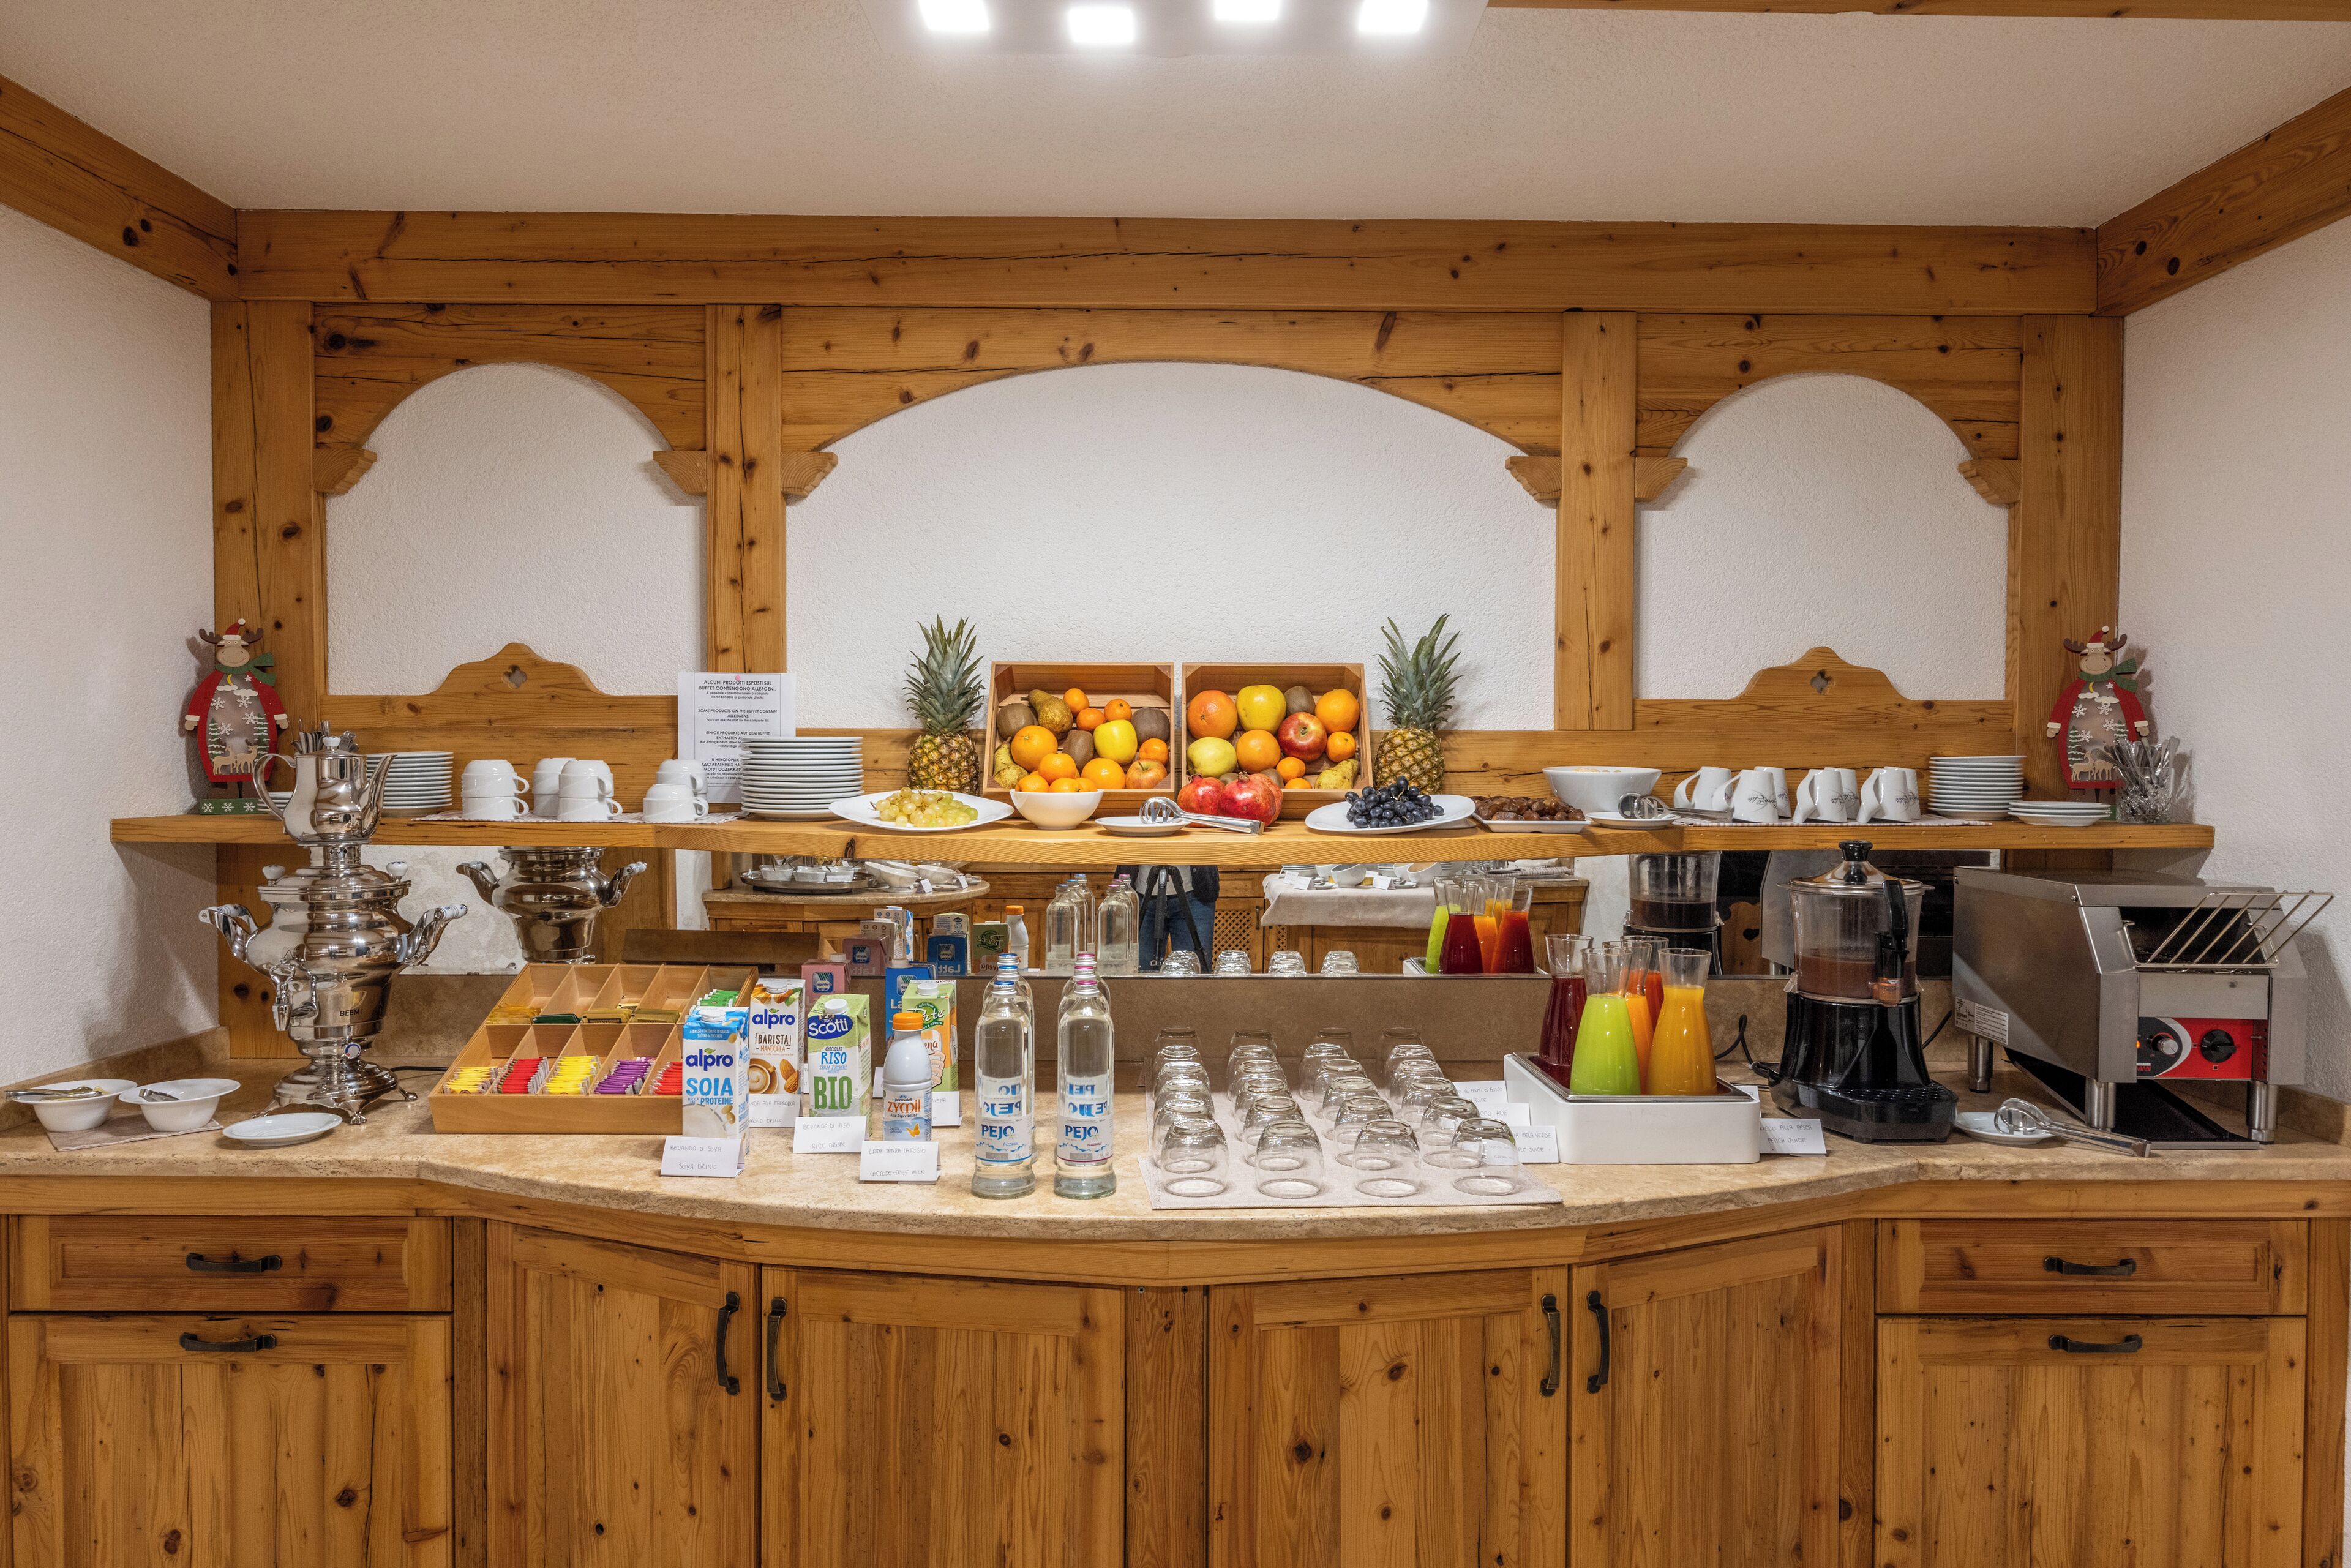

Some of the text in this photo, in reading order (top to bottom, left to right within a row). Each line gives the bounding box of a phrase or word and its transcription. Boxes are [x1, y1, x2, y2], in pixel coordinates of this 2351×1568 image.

[752, 1009, 795, 1029] alpro
[809, 1018, 849, 1036] Scotti
[758, 1035, 789, 1045] BARISTA
[685, 1049, 733, 1071] alpro
[821, 1052, 847, 1065] RISO
[686, 1078, 733, 1096] SOIA
[814, 1076, 852, 1109] BIO
[981, 1124, 1014, 1140] PEJO
[1065, 1125, 1098, 1141] PEJO
